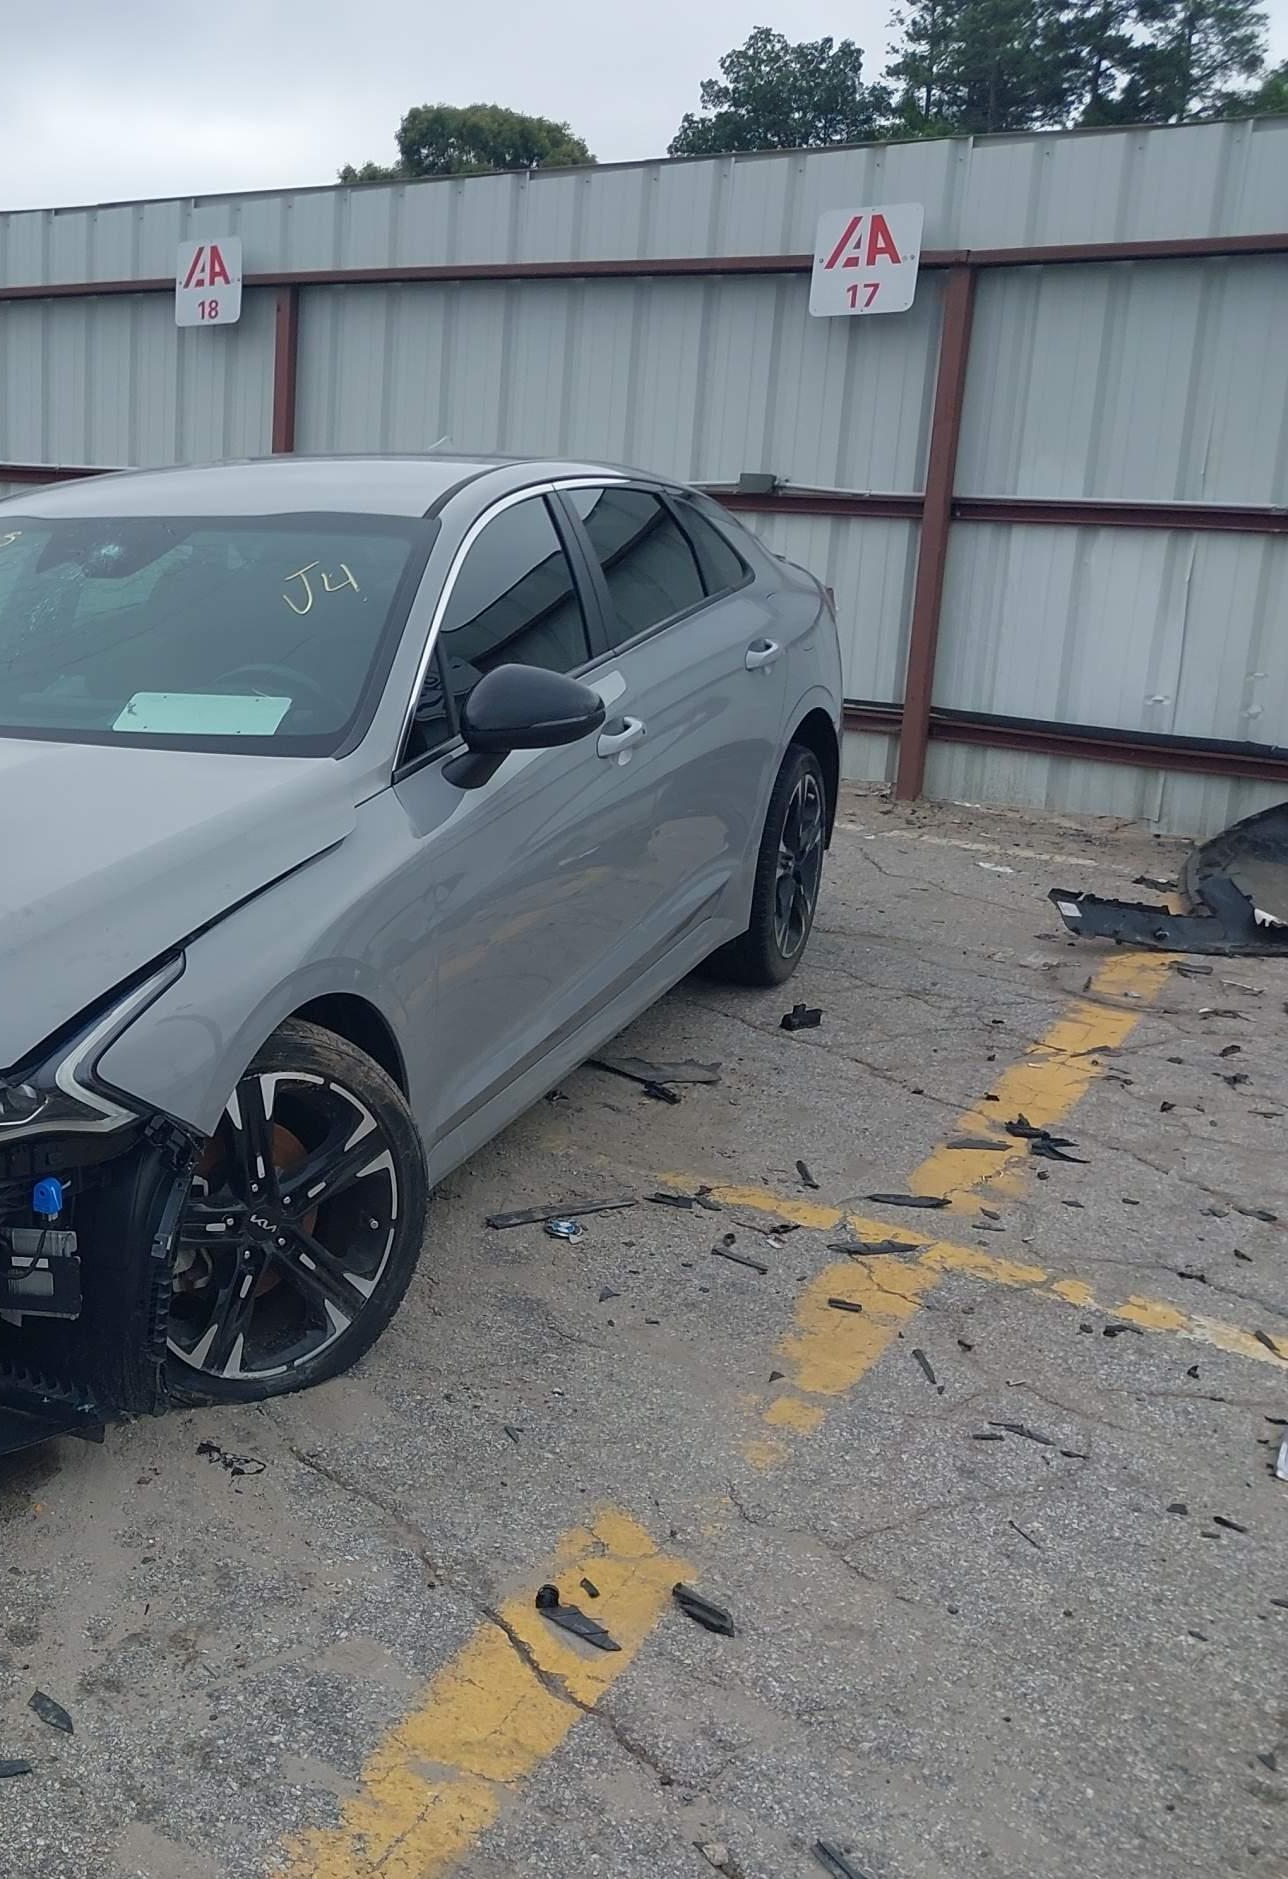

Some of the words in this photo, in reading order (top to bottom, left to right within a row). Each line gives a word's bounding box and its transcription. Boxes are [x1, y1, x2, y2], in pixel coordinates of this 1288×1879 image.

[846, 282, 880, 309] 17
[198, 299, 219, 320] 18
[283, 560, 360, 615] J4
[250, 1214, 277, 1233] KIA
